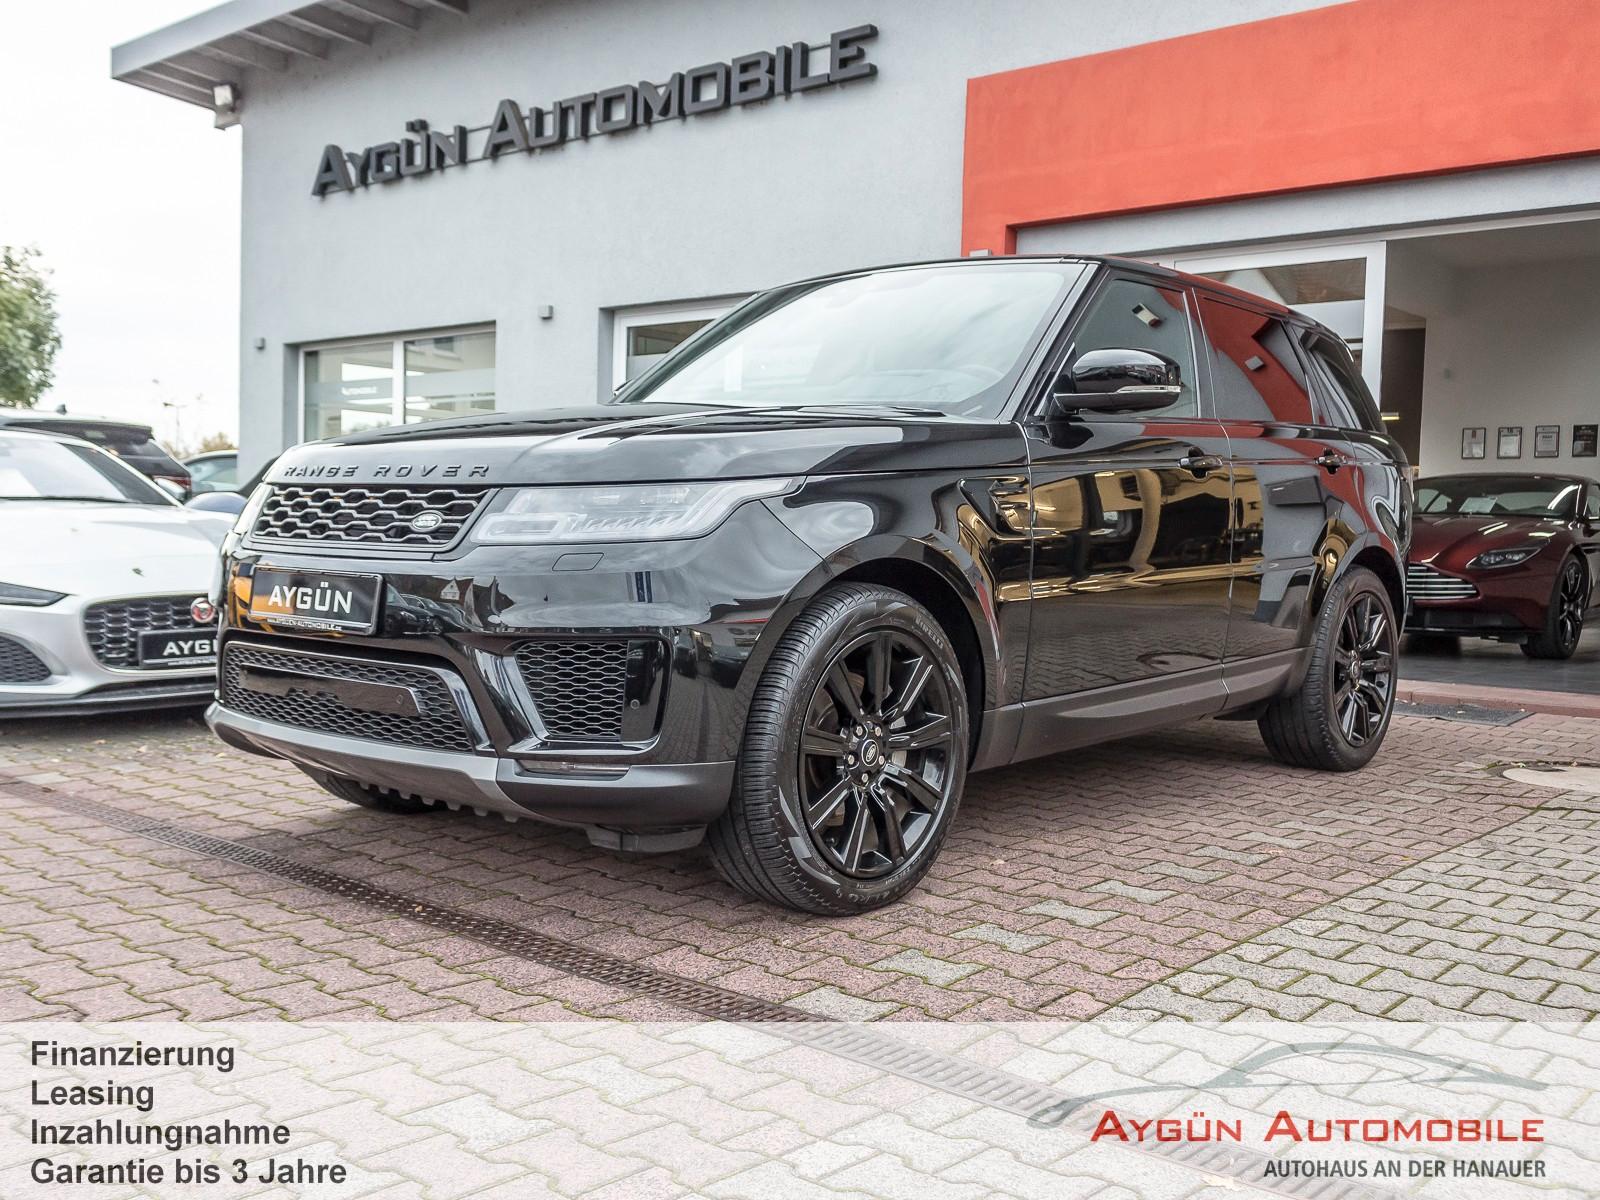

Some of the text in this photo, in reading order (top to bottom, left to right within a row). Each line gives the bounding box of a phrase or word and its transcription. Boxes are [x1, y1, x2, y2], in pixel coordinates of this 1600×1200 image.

[311, 24, 879, 197] AYGÜN AUTOMOBILE
[283, 464, 490, 478] RANGE ROVER
[268, 581, 353, 614] AYGÜN
